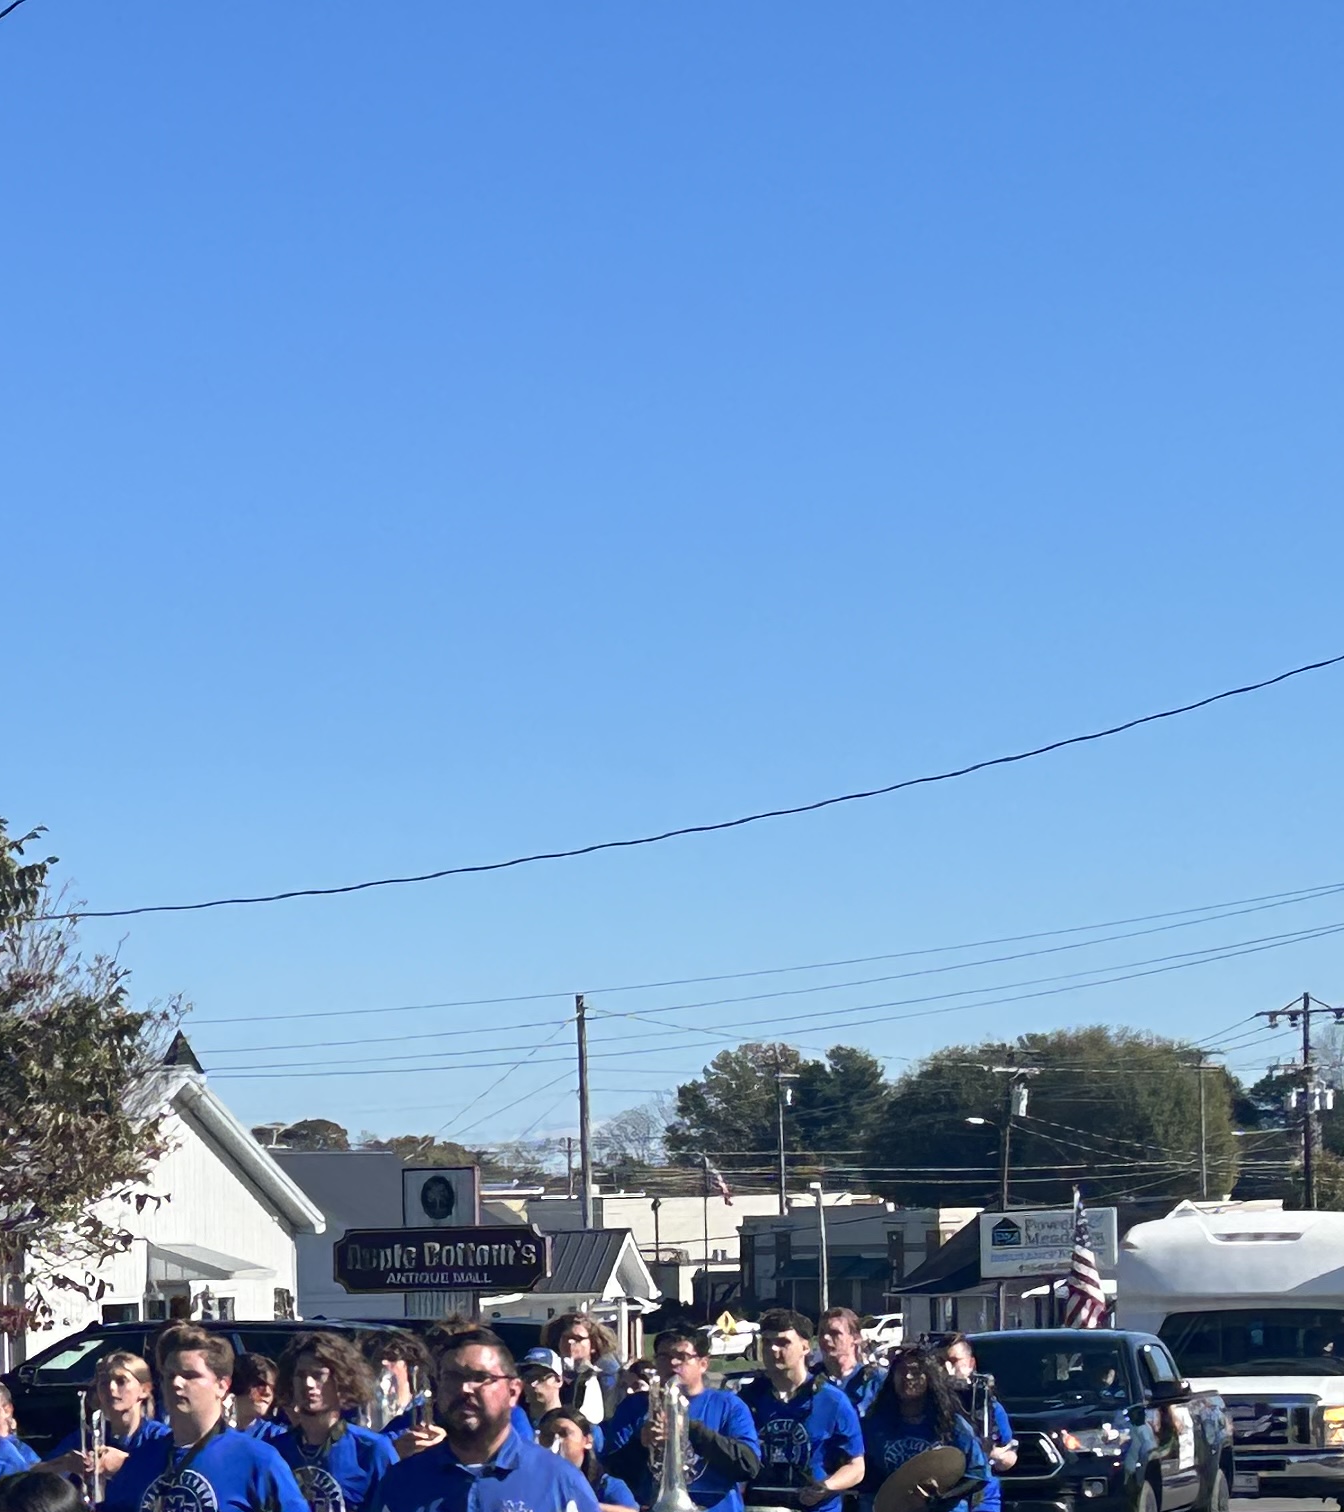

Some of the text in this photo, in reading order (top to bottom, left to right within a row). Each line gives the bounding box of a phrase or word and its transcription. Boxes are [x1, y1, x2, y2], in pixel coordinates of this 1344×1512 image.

[423, 1239, 537, 1268] Bottom's
[385, 1272, 492, 1285] ANTIQUE MALL
